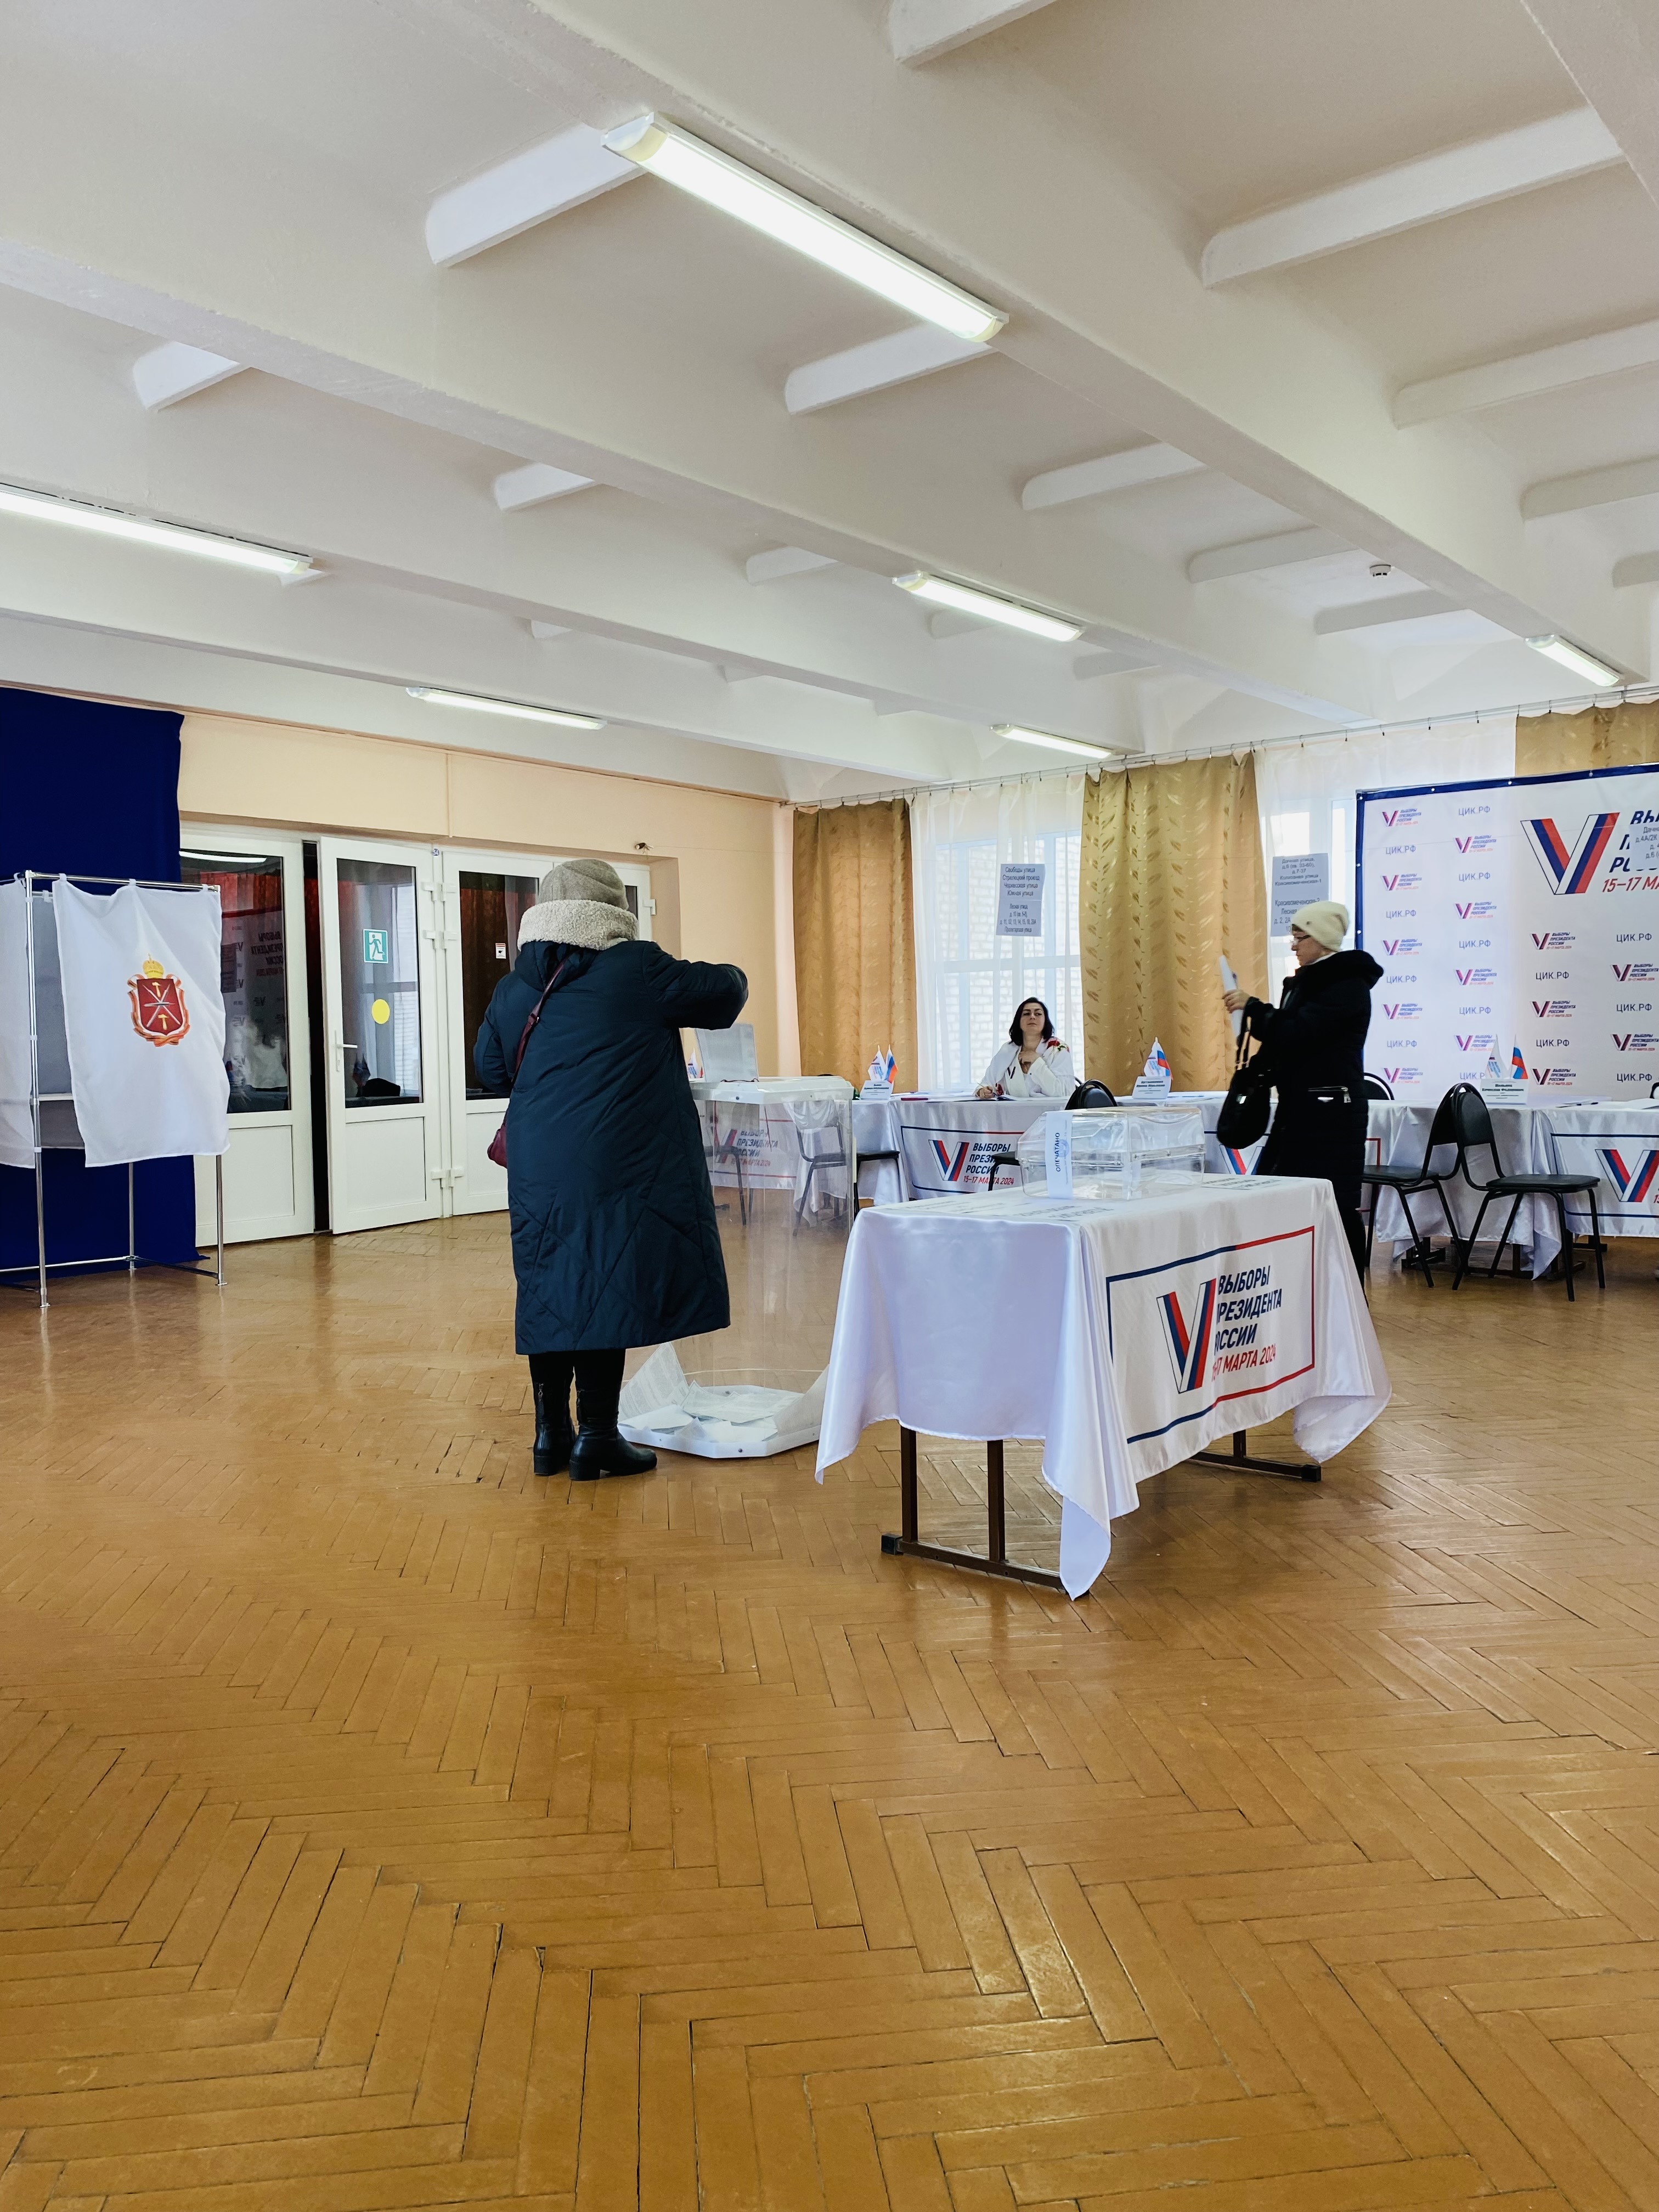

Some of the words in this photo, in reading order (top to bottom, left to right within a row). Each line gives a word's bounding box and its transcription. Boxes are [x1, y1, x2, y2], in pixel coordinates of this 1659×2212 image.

[973, 1143, 1011, 1152] ВЫБОРЫ
[1218, 1265, 1271, 1295] ВЫБОРЫ
[1222, 1350, 1258, 1373] МАРТА
